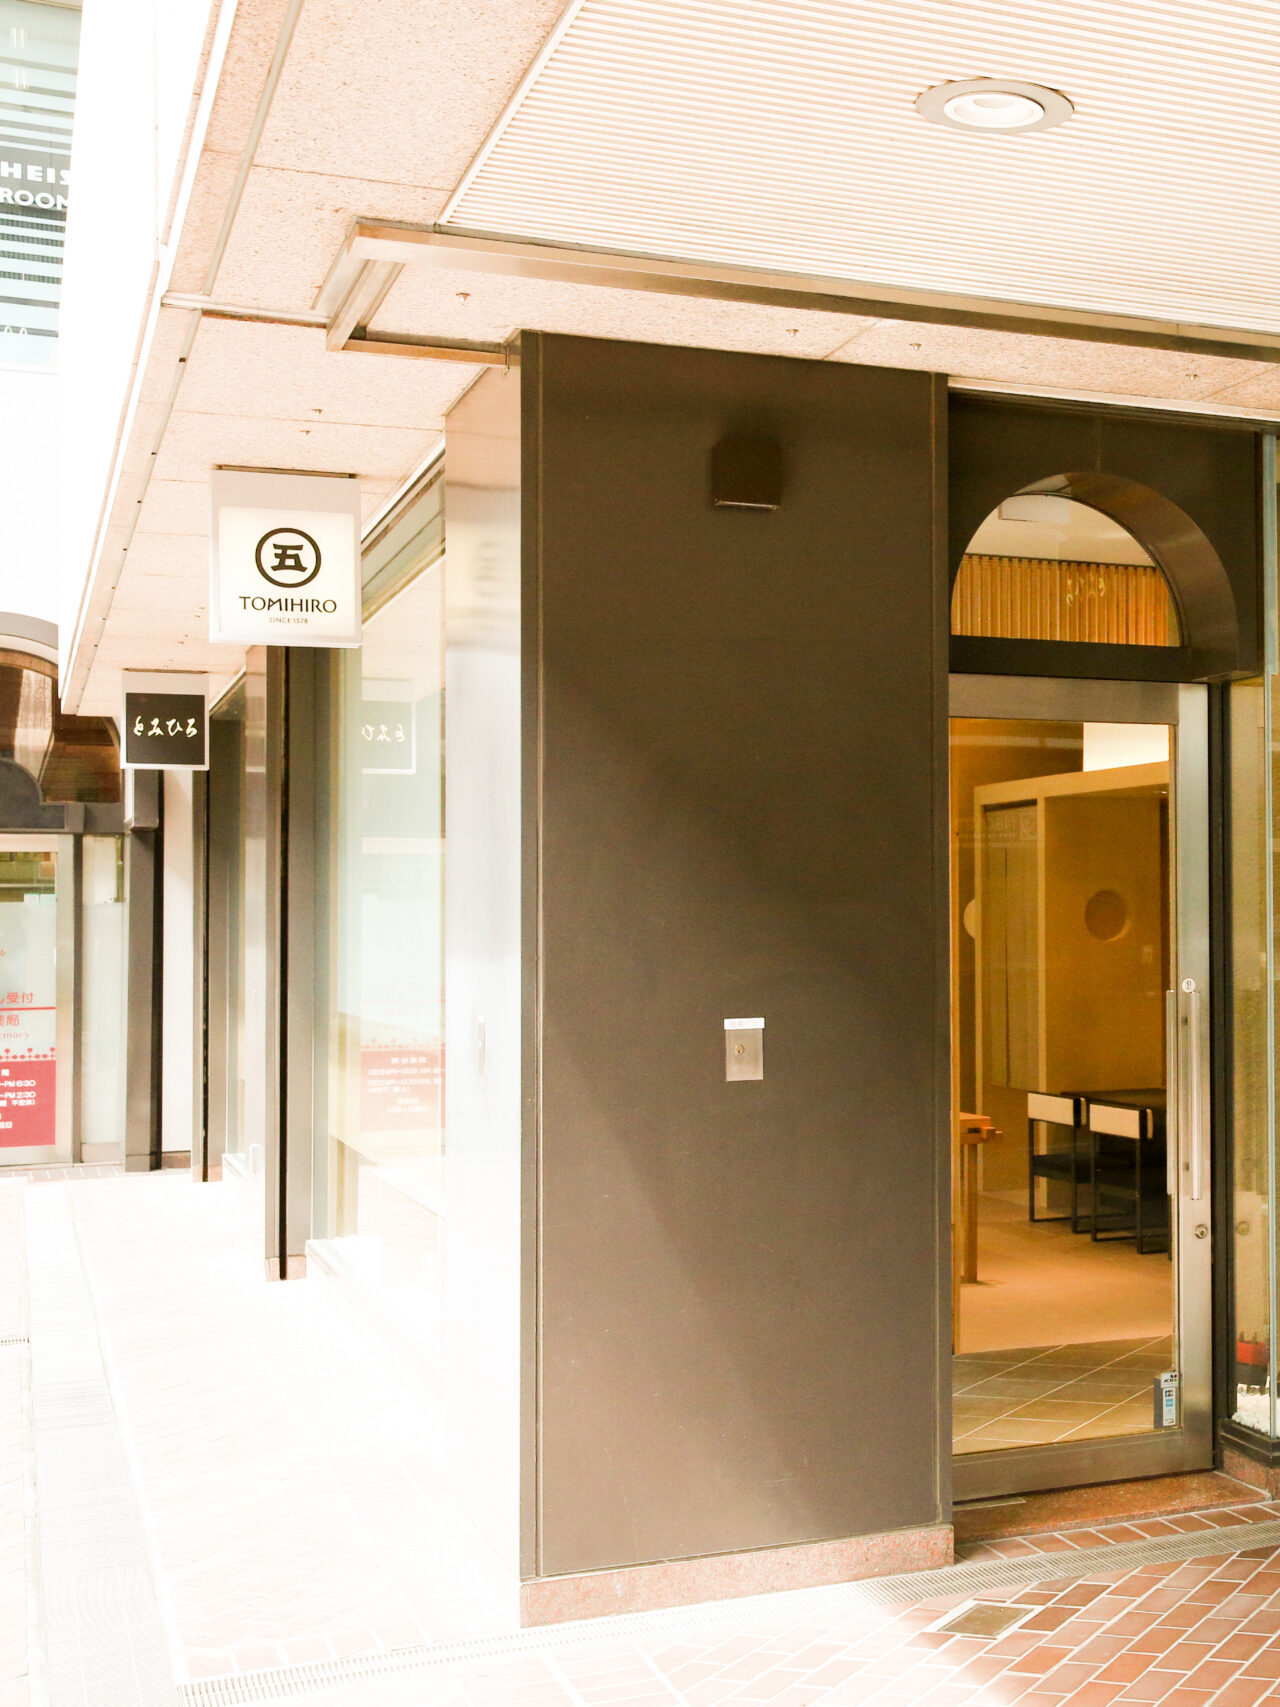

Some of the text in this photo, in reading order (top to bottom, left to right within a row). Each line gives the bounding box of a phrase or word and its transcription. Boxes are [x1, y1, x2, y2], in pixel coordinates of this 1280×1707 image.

[270, 543, 309, 573] 五
[239, 596, 337, 614] TOMIHIRO
[133, 715, 198, 738] とみひろ
